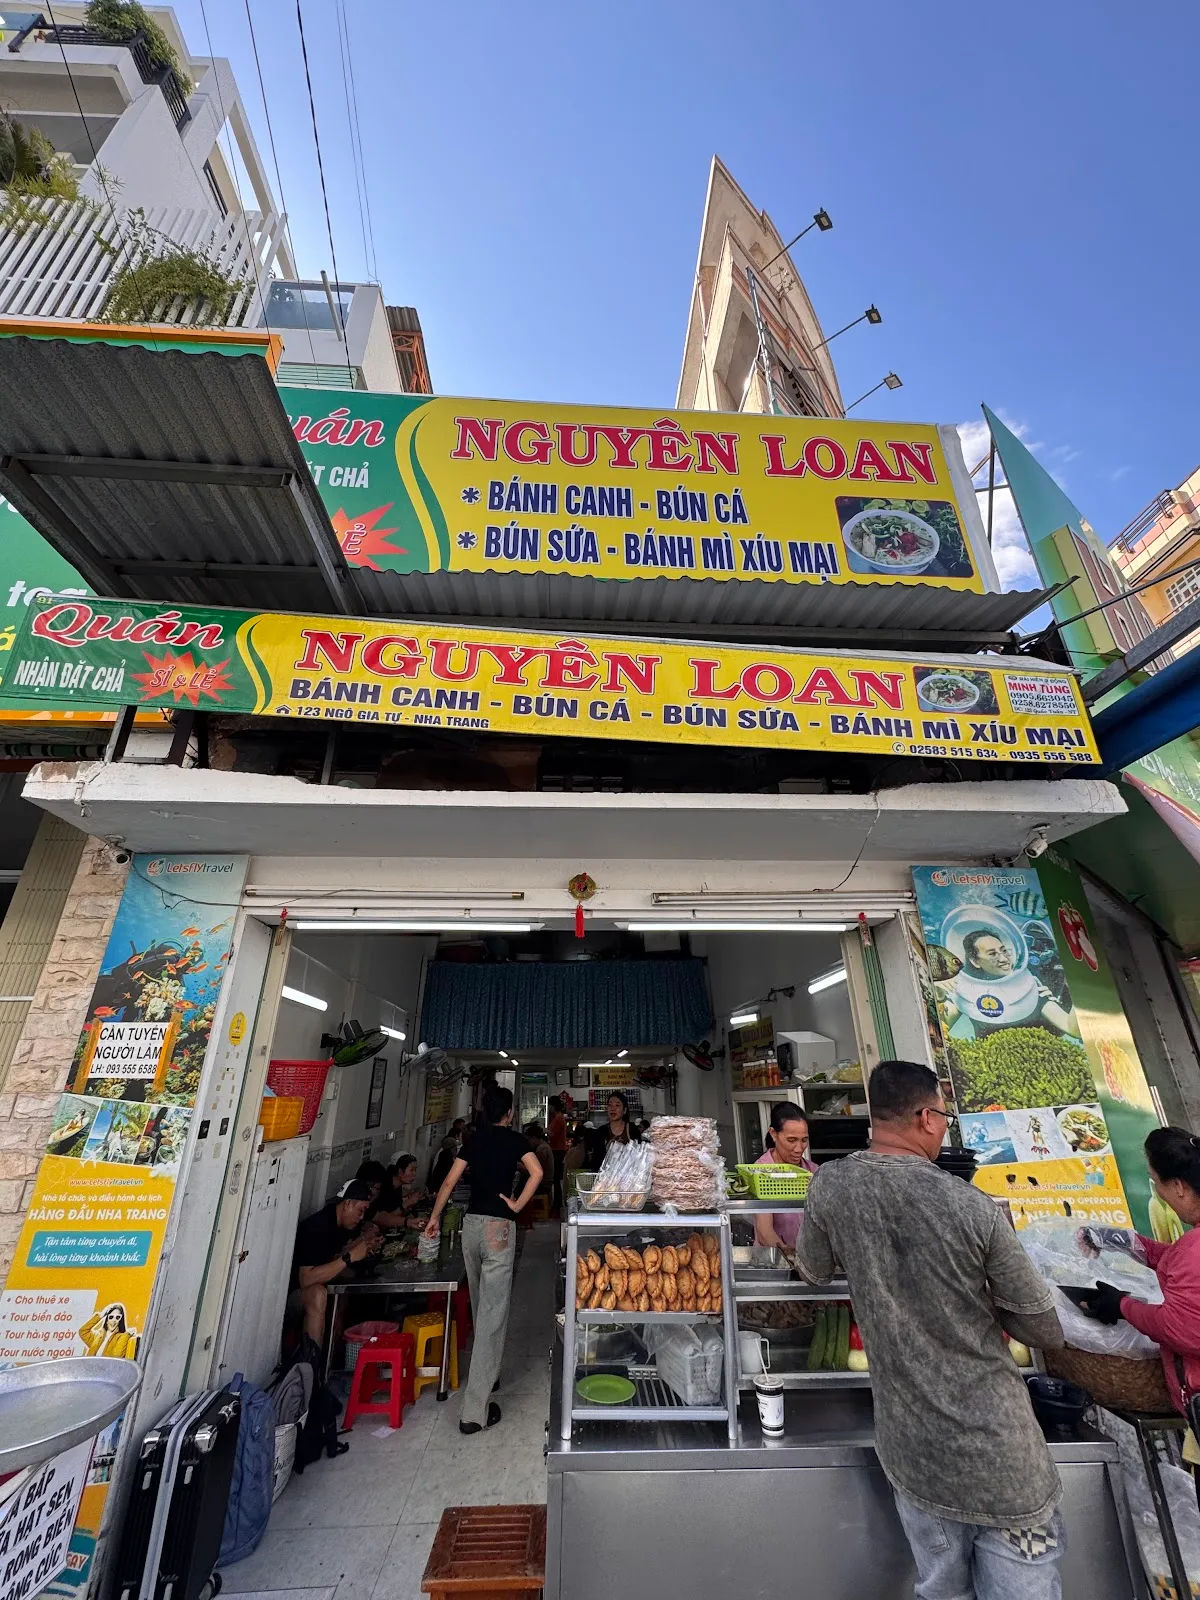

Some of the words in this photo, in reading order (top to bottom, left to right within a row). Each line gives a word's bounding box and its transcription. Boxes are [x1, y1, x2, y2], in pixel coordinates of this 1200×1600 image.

[288, 408, 385, 447] uán
[452, 416, 741, 475] NGUYÊN
[761, 434, 938, 485] LOAN
[328, 461, 370, 489] CHẢ
[488, 475, 558, 517] BÁNH
[564, 483, 634, 520] CANH
[657, 483, 709, 525] BÚN
[713, 487, 749, 526] CÁ
[484, 521, 540, 561] BÚN
[547, 526, 600, 565] SỨA
[624, 530, 696, 571] BÁNH
[701, 535, 734, 573] MÌ
[741, 537, 786, 575] XÍU
[790, 543, 841, 584] MẠI
[32, 603, 224, 649] Quán
[14, 656, 59, 693] NHẬN
[60, 660, 94, 695] ĐẶT
[96, 659, 126, 693] CHẢ
[172, 675, 187, 688] &
[187, 668, 217, 689] LẺ
[295, 629, 662, 694] NGUYÊN
[690, 658, 906, 710] LOAN
[1008, 682, 1037, 692] MINH
[1010, 692, 1073, 702] 0905.663045
[290, 677, 382, 704] BÁNH
[391, 687, 480, 711] CANH
[513, 690, 579, 719] BÚN
[588, 697, 632, 723] CÁ
[662, 701, 727, 729] BÚN
[739, 705, 800, 733] SỨA
[831, 713, 912, 740] BÁNH
[922, 718, 961, 742] MÌ
[970, 721, 1017, 745] XÍU
[1025, 728, 1087, 750] MẠI
[1012, 699, 1076, 709] 0258.6278550
[297, 706, 320, 717] 123
[357, 710, 379, 721] GIA
[384, 712, 402, 725] TỰ
[414, 715, 441, 726] NHA
[446, 716, 490, 729] TRANG
[909, 744, 947, 756] 02583
[950, 747, 972, 758] 515
[976, 748, 998, 759] 634
[1010, 751, 1040, 760] 0935
[1043, 752, 1066, 761] 556
[1070, 753, 1093, 762] 588
[94, 1043, 135, 1059] NGƯỜI
[136, 1043, 163, 1059] LÀM
[90, 1064, 104, 1074] LH:
[106, 1064, 120, 1073] 093
[122, 1064, 137, 1073] 555
[138, 1064, 157, 1073] 6588
[29, 1206, 64, 1220] HÀNG
[96, 1209, 122, 1220] NHA
[126, 1209, 167, 1220] TRANG
[15, 1295, 34, 1305] Cho
[36, 1294, 56, 1305] thuê
[57, 1297, 70, 1305] xe
[10, 1312, 30, 1322] Tour
[5, 1330, 25, 1340] Tour
[26, 1329, 51, 1341] hàng
[53, 1329, 77, 1341] ngày
[0, 1347, 20, 1358] Tour
[21, 1346, 45, 1358] nước
[47, 1346, 75, 1360] ngoài
[13, 1501, 46, 1548] HẠT
[46, 1477, 74, 1517] SEN
[1, 1569, 33, 1600] ÔNG
[35, 1543, 62, 1583] CÚC
[2, 1534, 42, 1588] RONG
